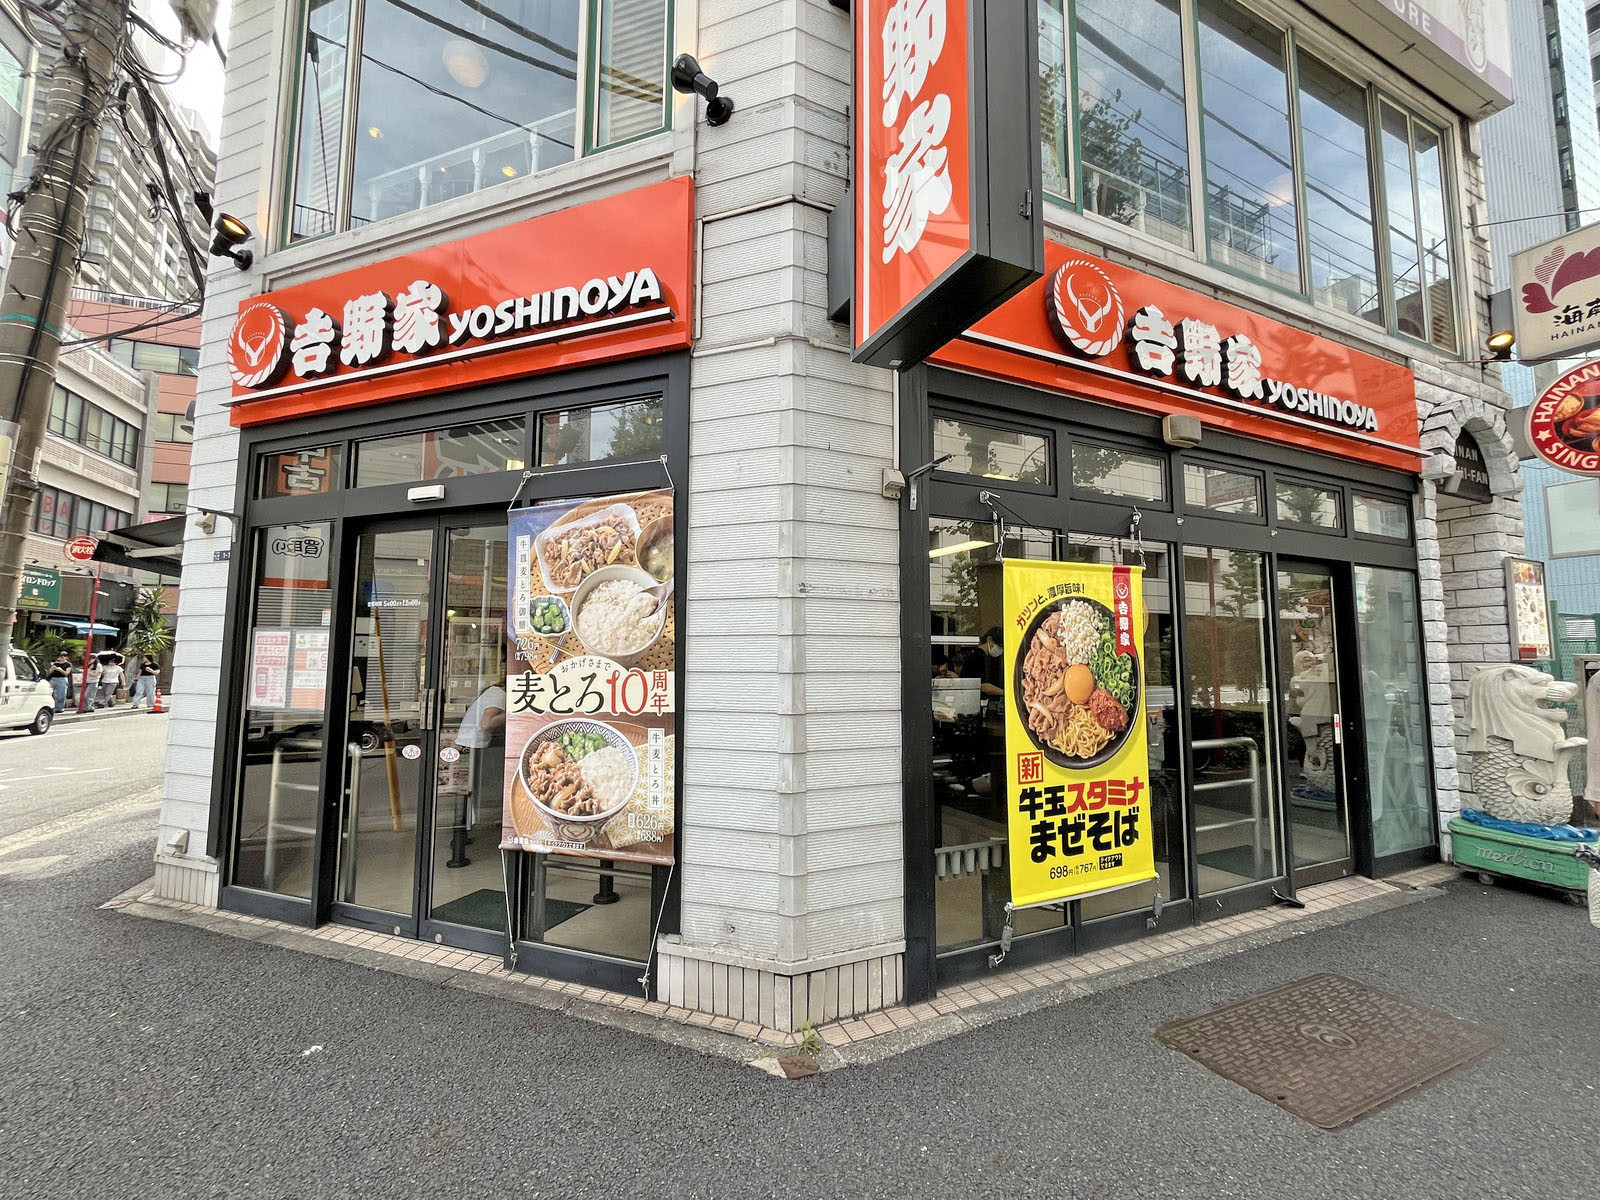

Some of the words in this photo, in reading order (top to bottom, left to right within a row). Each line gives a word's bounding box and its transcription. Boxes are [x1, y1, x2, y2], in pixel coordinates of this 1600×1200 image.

[290, 281, 444, 377] 吉野家
[448, 268, 661, 345] YOSHINOYA
[1551, 321, 1600, 341] HAINA
[1131, 305, 1264, 400] 吉野家
[1267, 378, 1379, 431] YOSHINOYA
[1544, 442, 1599, 469] SING
[1118, 600, 1131, 646] 吉野家
[1020, 755, 1042, 781] 新
[1018, 776, 1144, 820] 牛玉スタミナ
[1030, 807, 1140, 863] まぜそば
